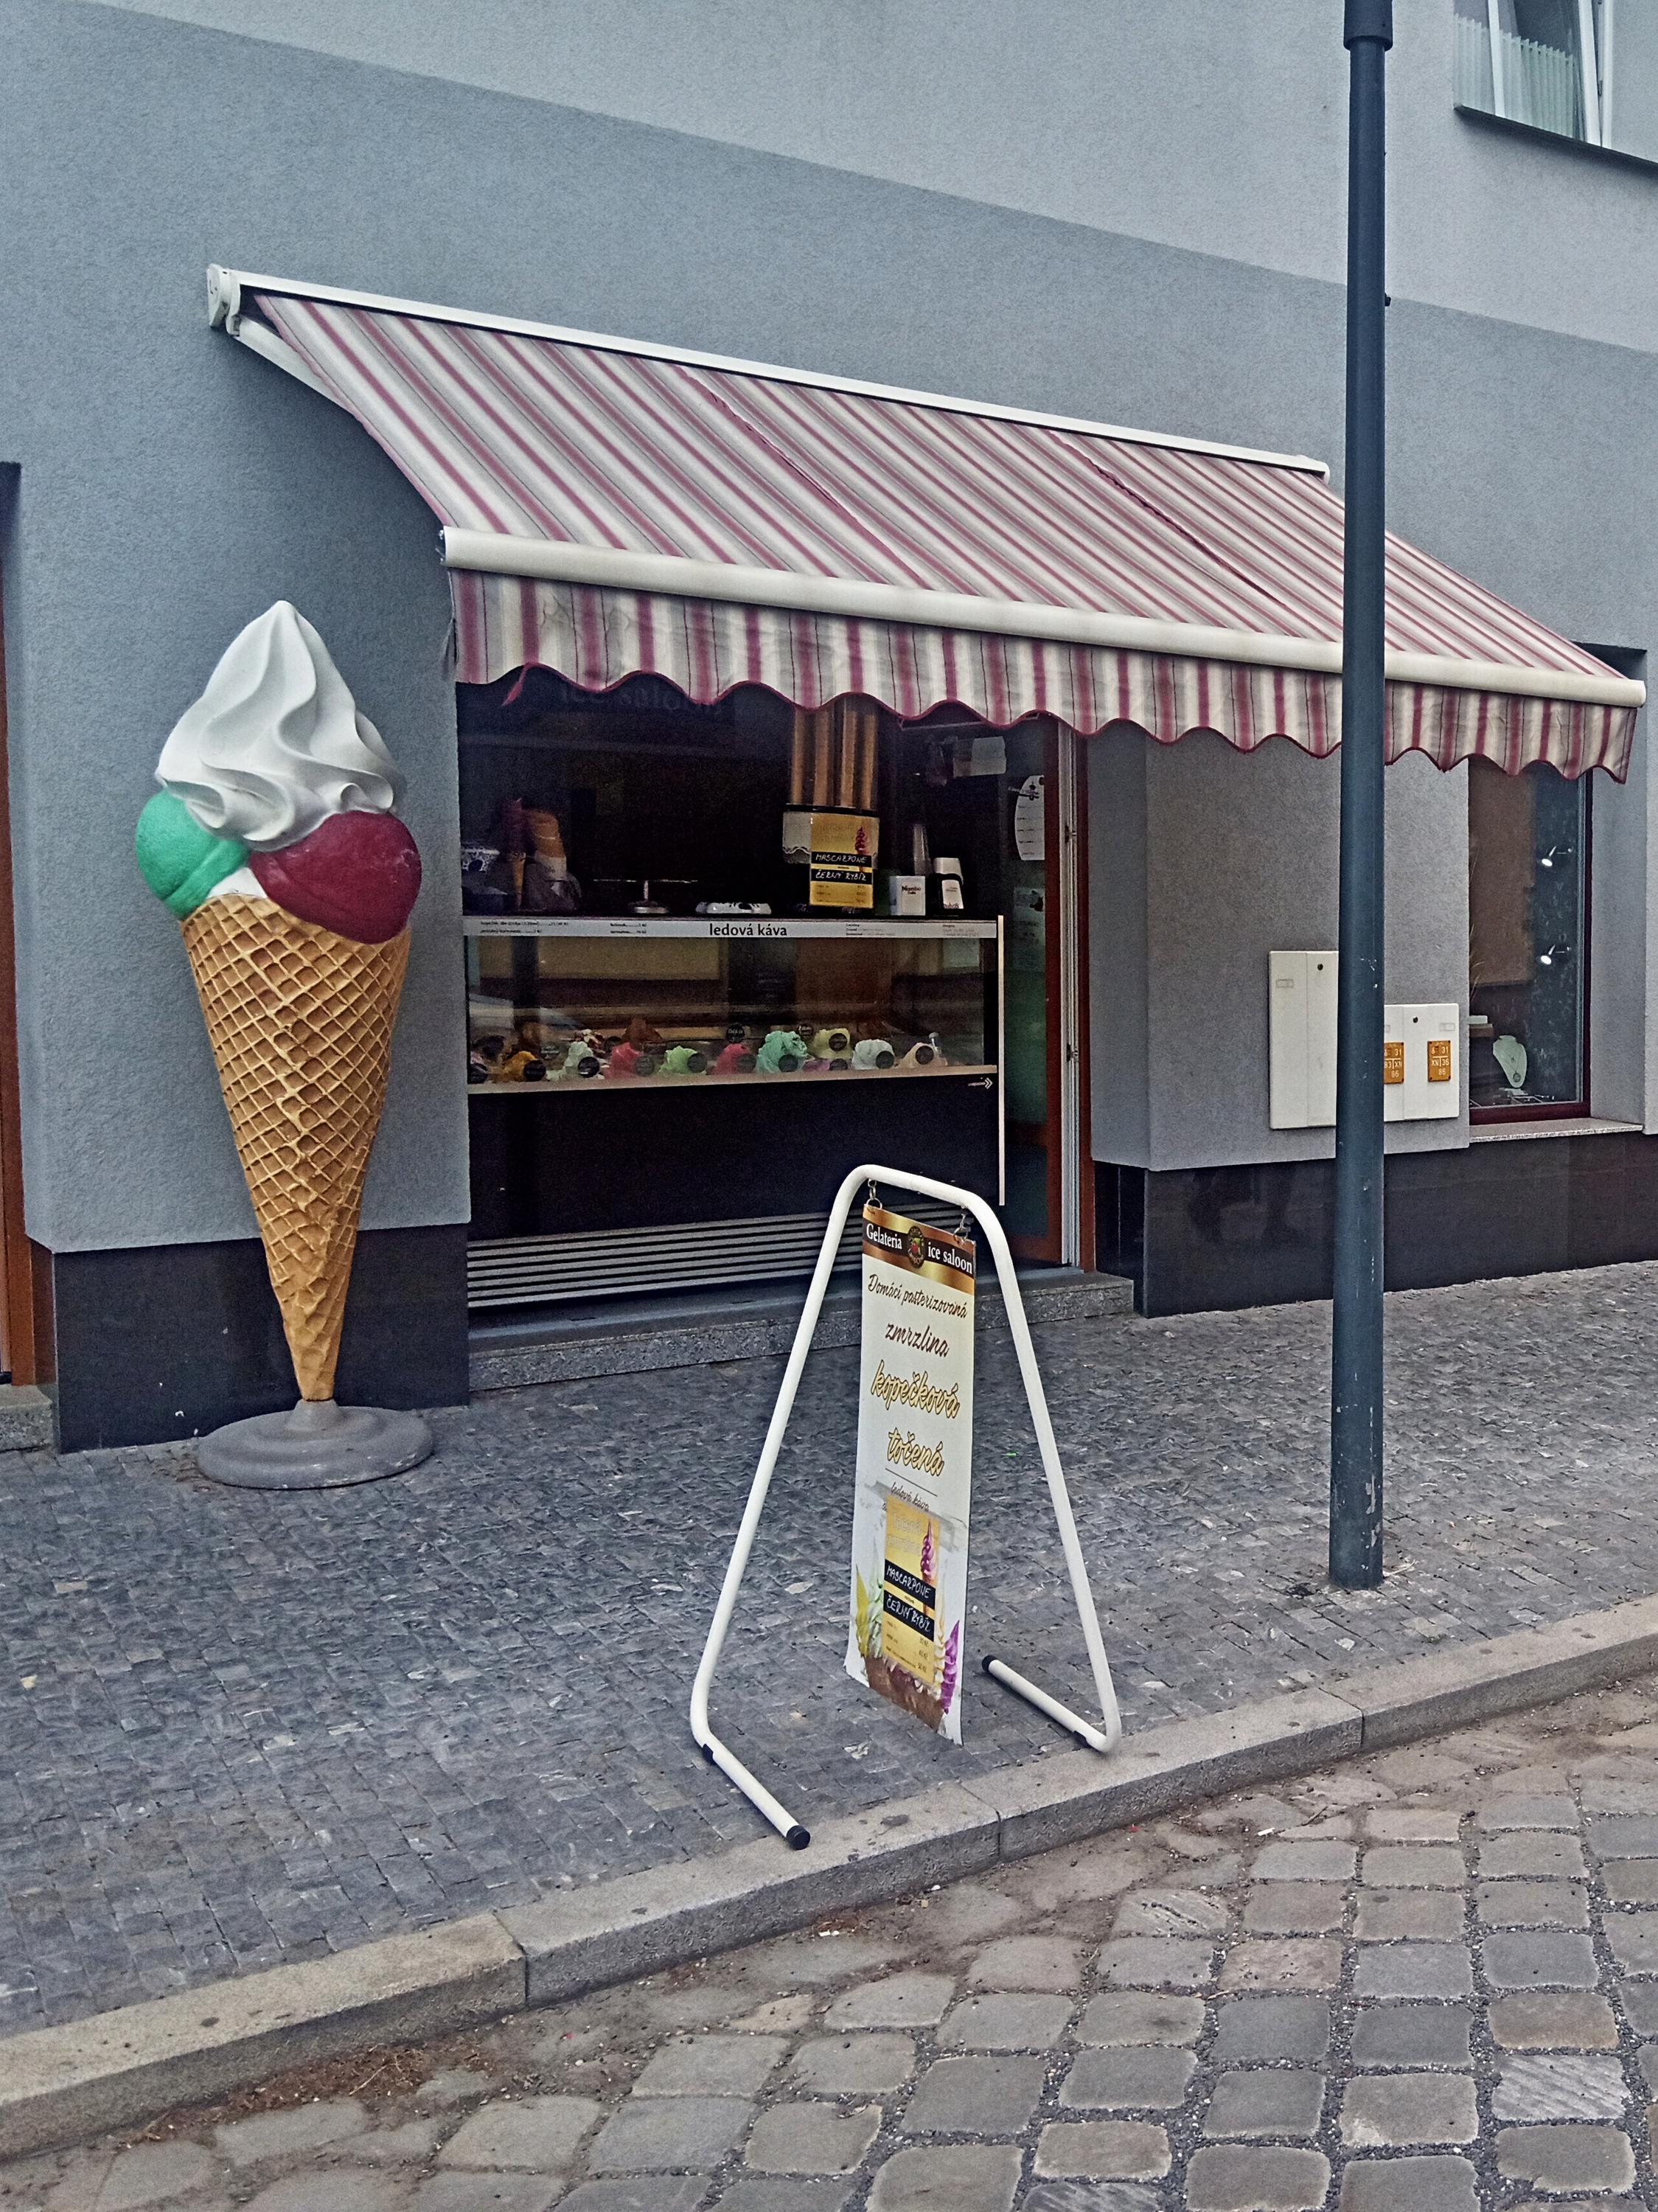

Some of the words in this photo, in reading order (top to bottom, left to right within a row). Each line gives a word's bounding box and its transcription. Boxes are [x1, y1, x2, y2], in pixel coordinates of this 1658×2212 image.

[709, 923, 753, 936] ledová
[758, 923, 787, 936] káva
[865, 1223, 902, 1250] Gelateria
[927, 1242, 941, 1260] ice
[943, 1248, 973, 1275] saloon
[868, 1273, 902, 1300] Domácí
[901, 1290, 967, 1319] pasterizovaná
[885, 1323, 950, 1357] zmrzlina
[871, 1359, 961, 1419] kopečková
[887, 1427, 945, 1477] točená
[886, 1565, 932, 1599] MASCARPONE
[886, 1595, 912, 1621] ČERNÝ
[911, 1610, 931, 1632] RYBÍZ
